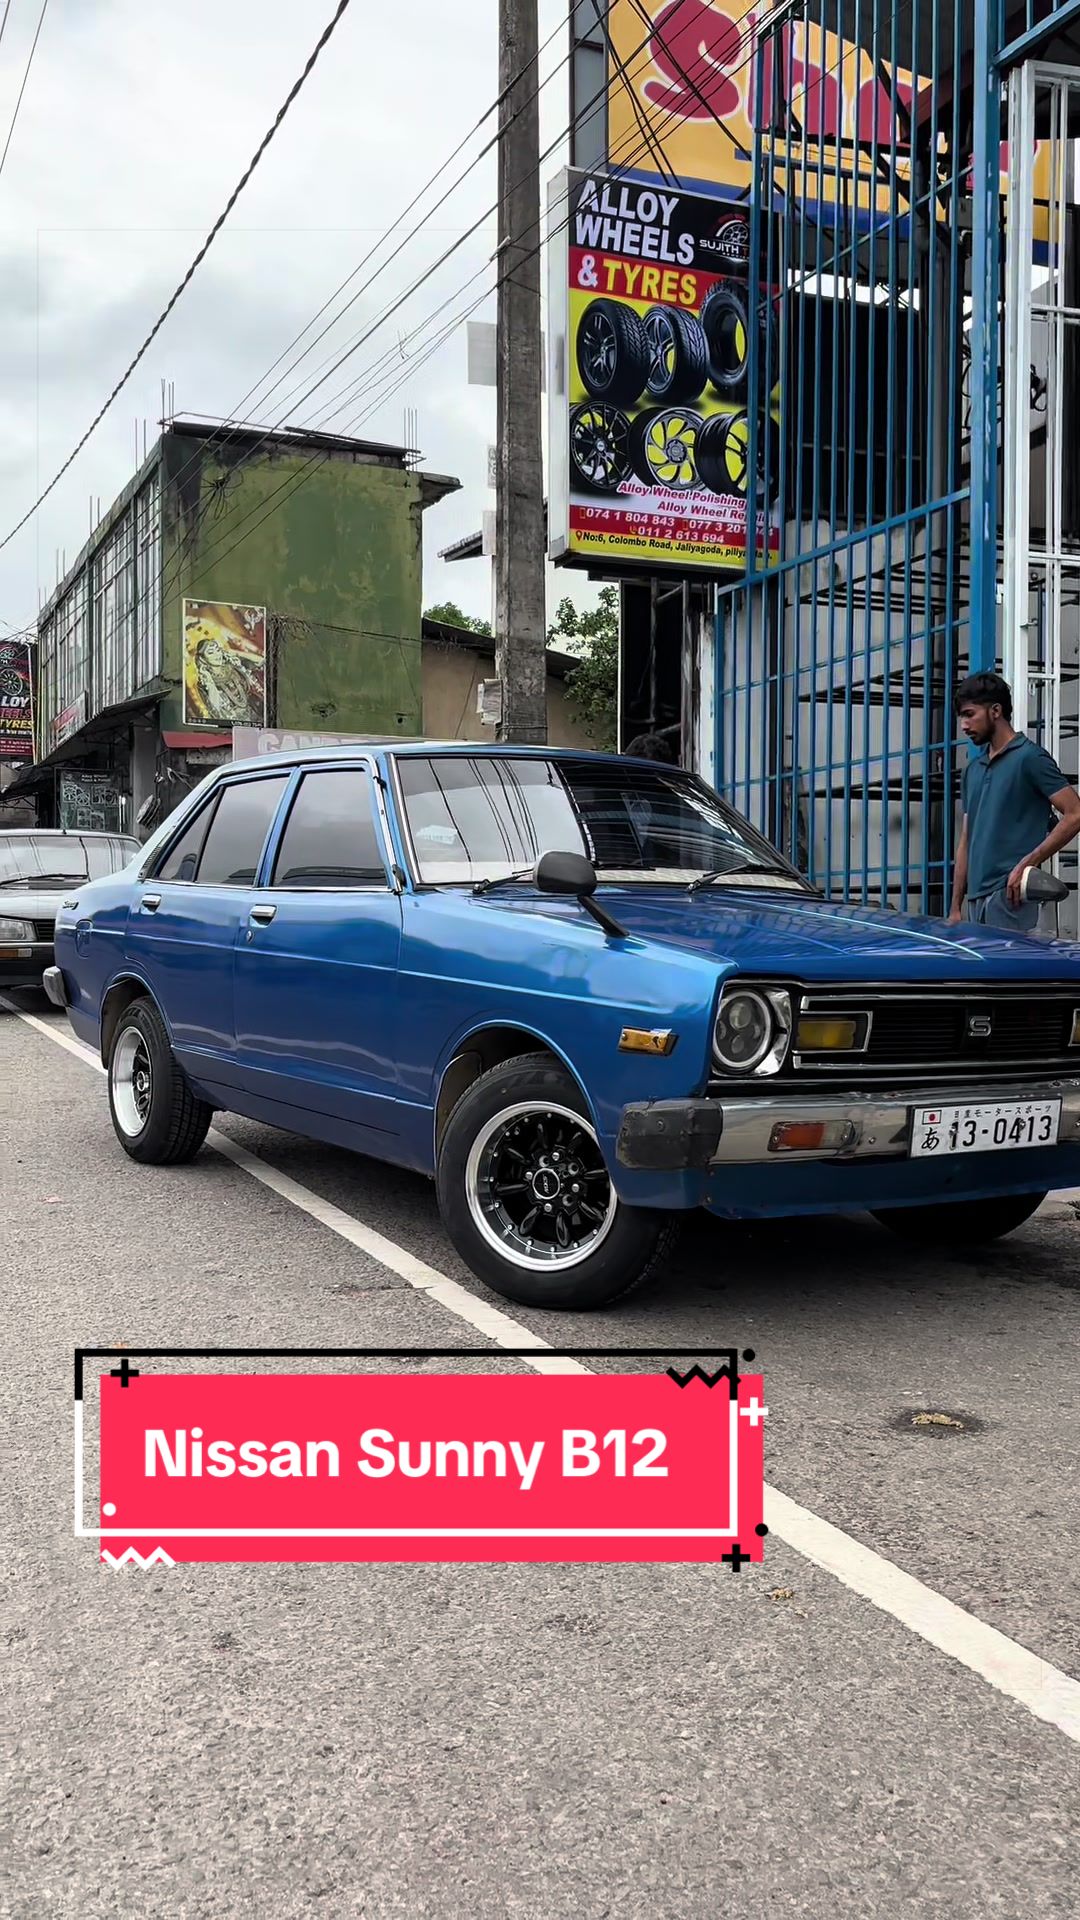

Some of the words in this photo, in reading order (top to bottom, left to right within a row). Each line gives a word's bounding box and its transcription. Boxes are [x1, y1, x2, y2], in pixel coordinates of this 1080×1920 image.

[578, 179, 680, 226] ALLOY
[575, 211, 695, 266] WHEELS
[699, 238, 740, 255] SUJITH
[577, 254, 599, 288] &
[602, 257, 697, 306] TYRES
[618, 482, 651, 497] Alloy
[652, 486, 689, 501] Wheel
[586, 507, 610, 520] 074
[614, 511, 621, 521] 1
[625, 512, 649, 524] 804
[652, 515, 675, 527] 843
[657, 500, 688, 515] Alloy
[691, 504, 727, 518] Wheel
[689, 519, 712, 530] 077
[608, 534, 647, 547] Colombo
[649, 538, 673, 551] Road,
[638, 525, 660, 537] 011
[664, 529, 672, 539] 2
[676, 530, 699, 542] 613
[702, 532, 725, 544] 694
[968, 1015, 992, 1037] S
[920, 1126, 940, 1151] あ
[950, 1114, 1053, 1149] 13-0413
